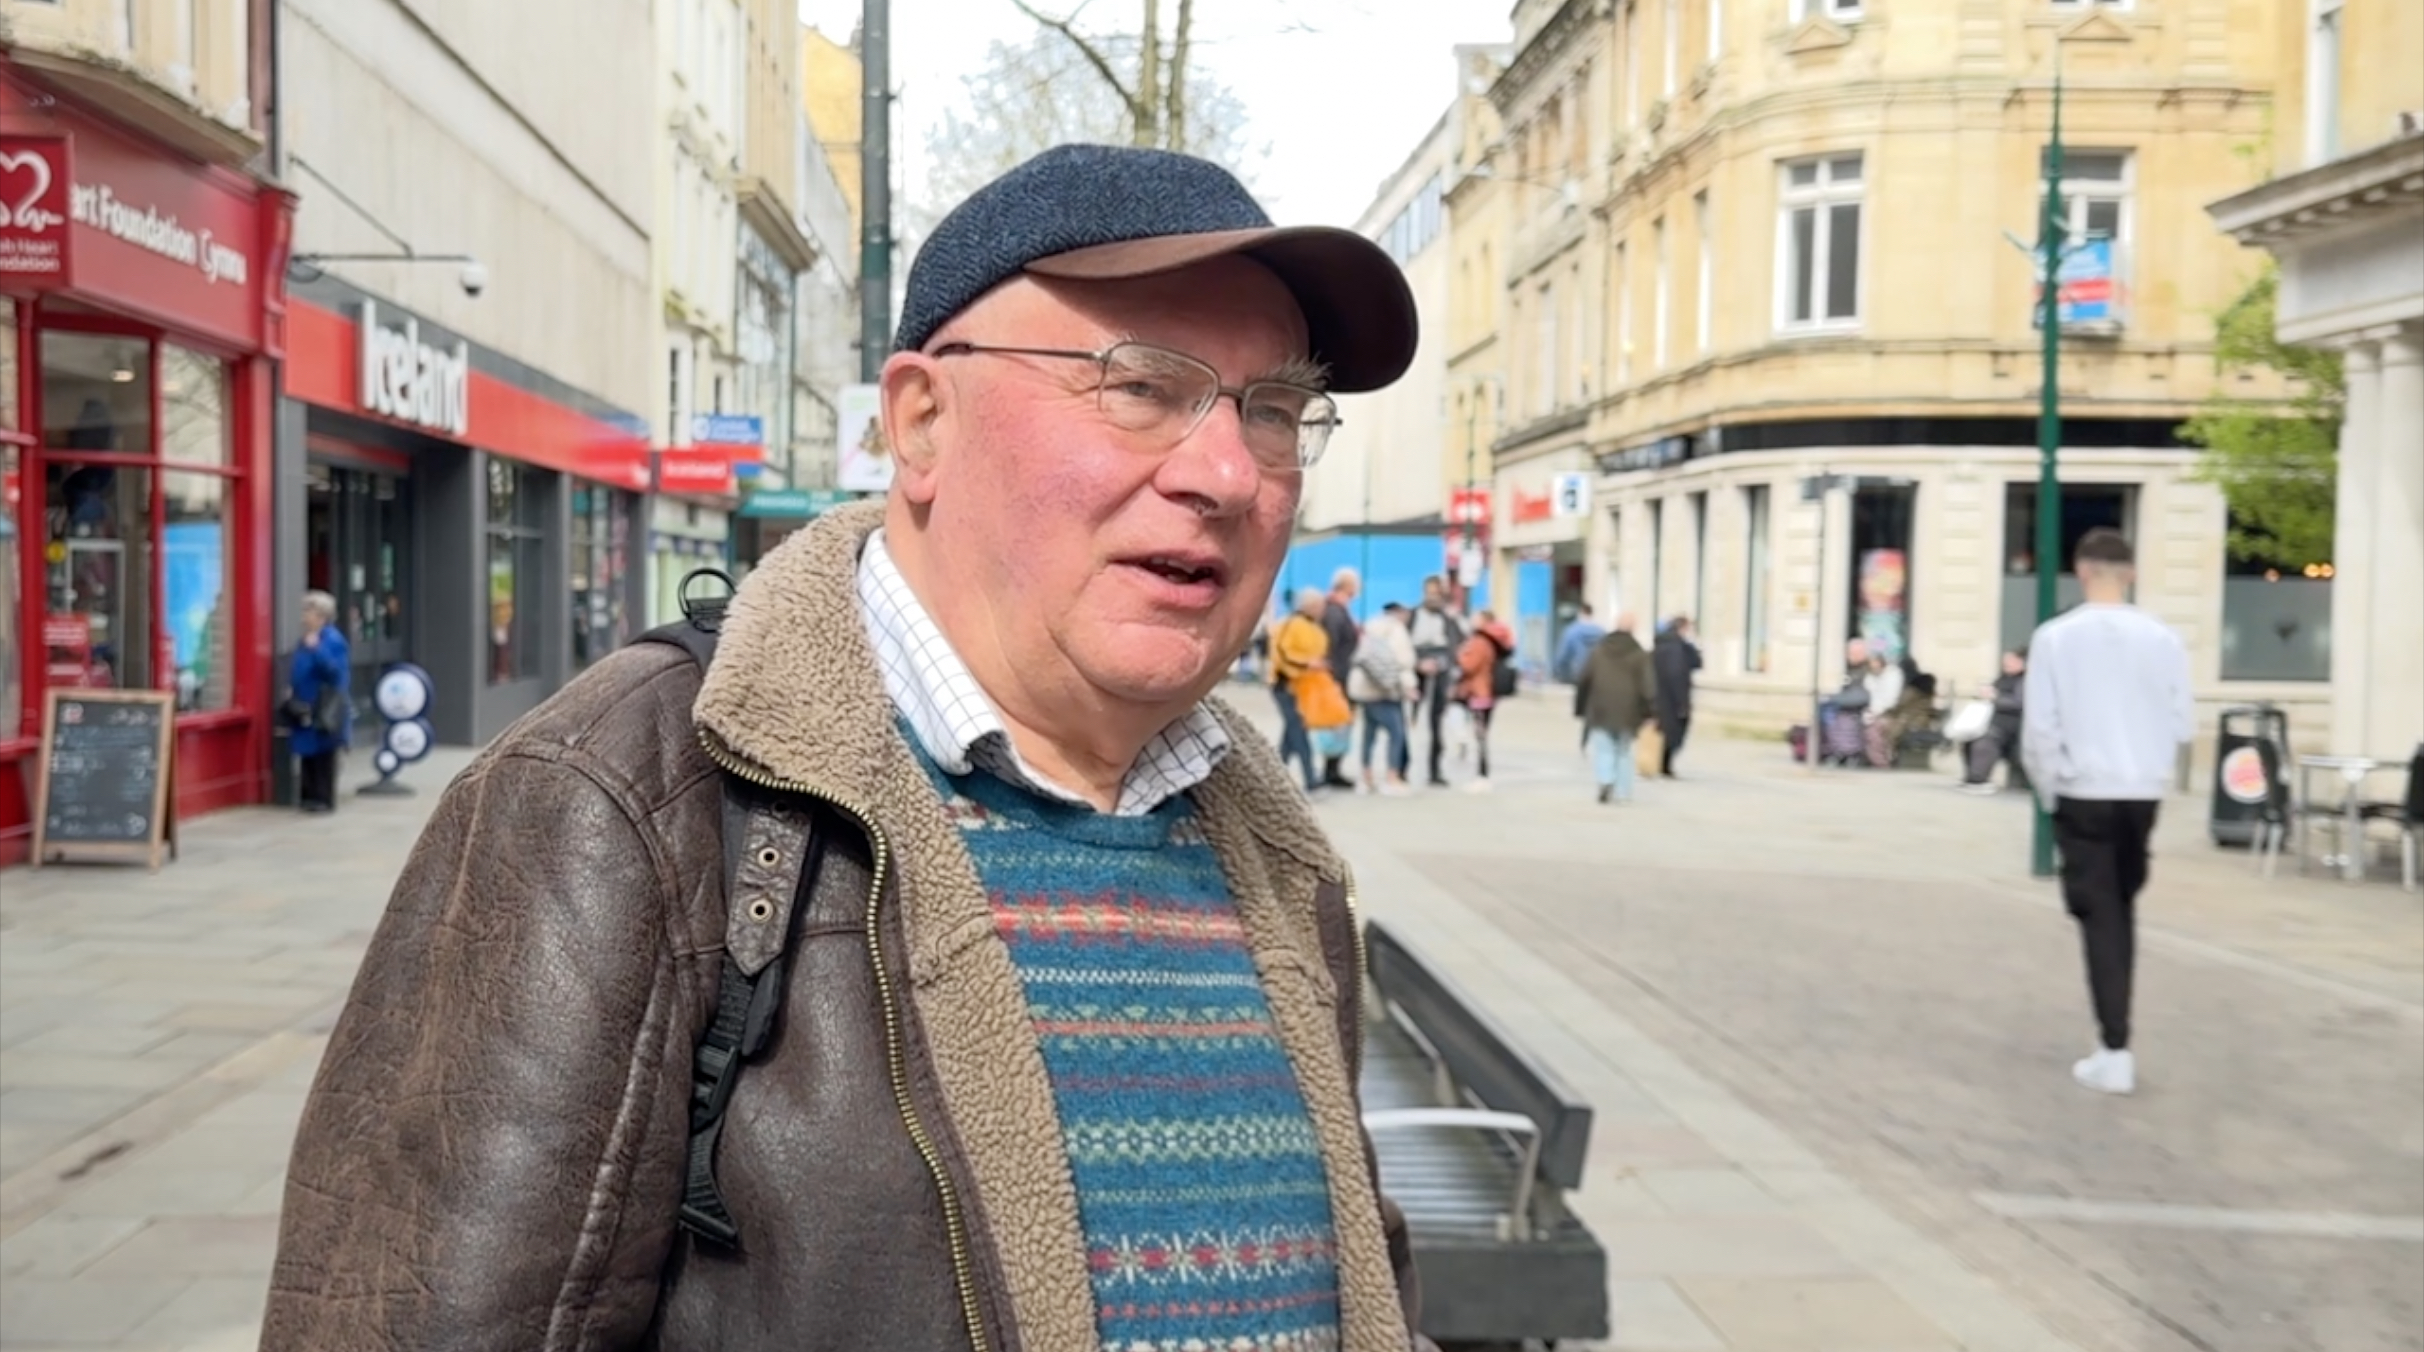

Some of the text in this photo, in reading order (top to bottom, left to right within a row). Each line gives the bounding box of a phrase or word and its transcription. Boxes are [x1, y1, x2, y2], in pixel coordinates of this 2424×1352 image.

[0, 256, 60, 271] ndation
[71, 182, 98, 226] art
[99, 184, 196, 265] Foundation
[362, 298, 468, 437] Iceland
